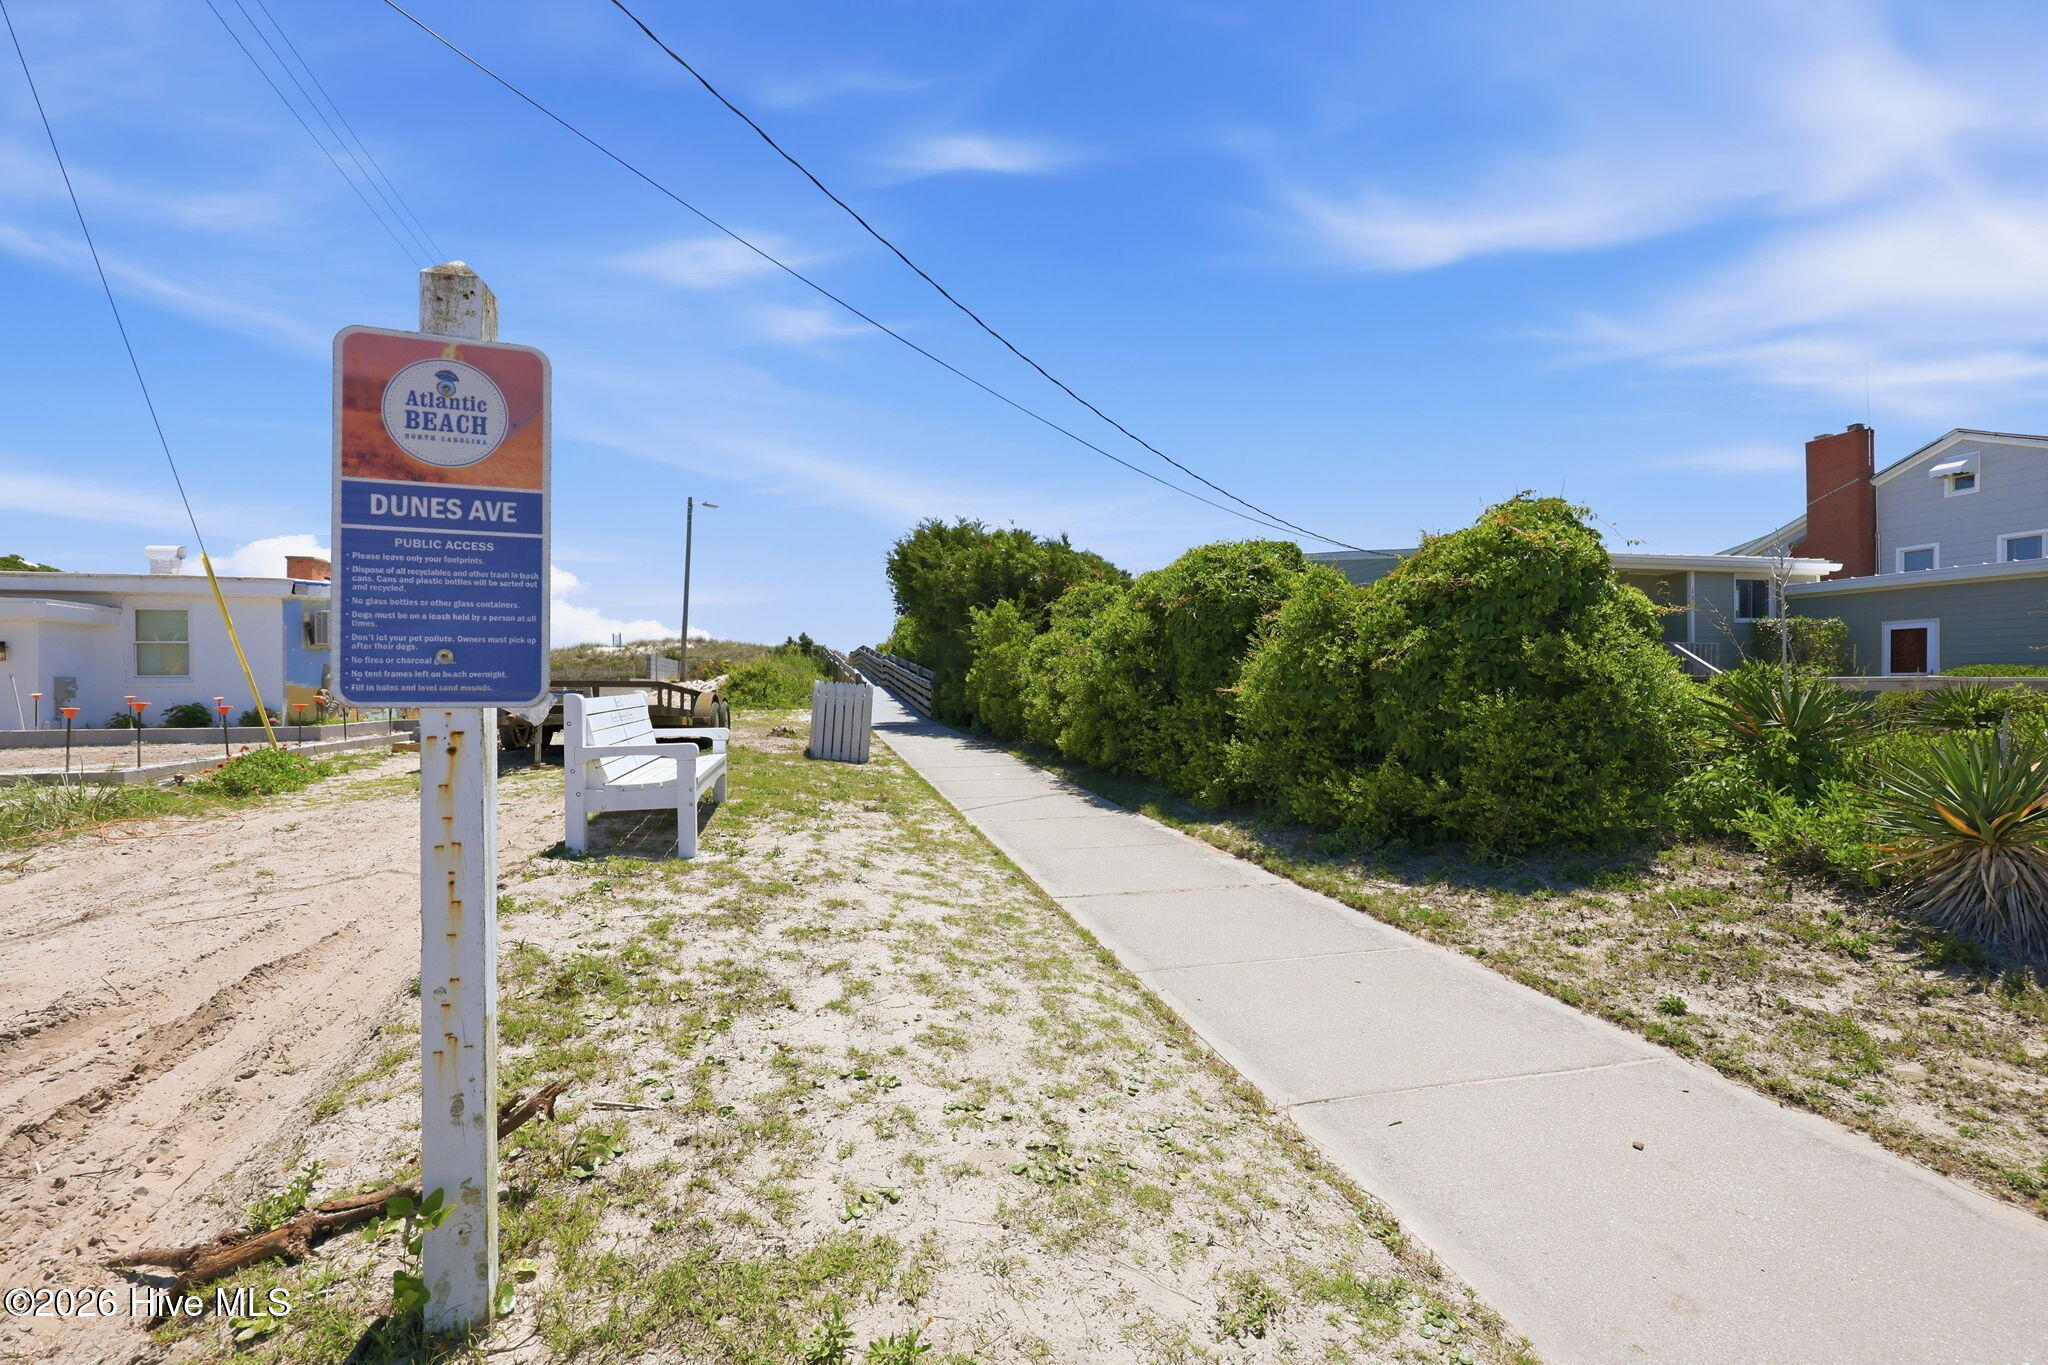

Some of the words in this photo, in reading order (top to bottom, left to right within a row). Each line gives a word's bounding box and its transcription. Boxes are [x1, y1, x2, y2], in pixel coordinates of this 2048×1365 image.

[406, 390, 486, 412] Atlantic
[404, 410, 488, 435] BEACH
[404, 433, 436, 441] NORTH
[441, 436, 487, 446] CAROLINA
[370, 494, 462, 520] DUNES
[468, 500, 517, 522] AVE
[394, 538, 442, 549] PUBLIC
[445, 540, 494, 552] ACCESS
[352, 552, 380, 560] Please
[382, 553, 404, 561] leave
[406, 554, 422, 563] only
[444, 556, 485, 564] footprints.
[352, 566, 384, 574] Dispose
[408, 568, 451, 576] recyclables
[444, 578, 472, 586] bottles
[366, 598, 387, 606] glass
[390, 598, 418, 606] bottles
[454, 600, 474, 608] glass
[352, 610, 373, 619] Dogs
[472, 614, 481, 622] by
[424, 635, 455, 643] pollute.
[508, 636, 525, 644] pick
[396, 643, 418, 652] dogs.
[468, 671, 508, 679] overnight.
